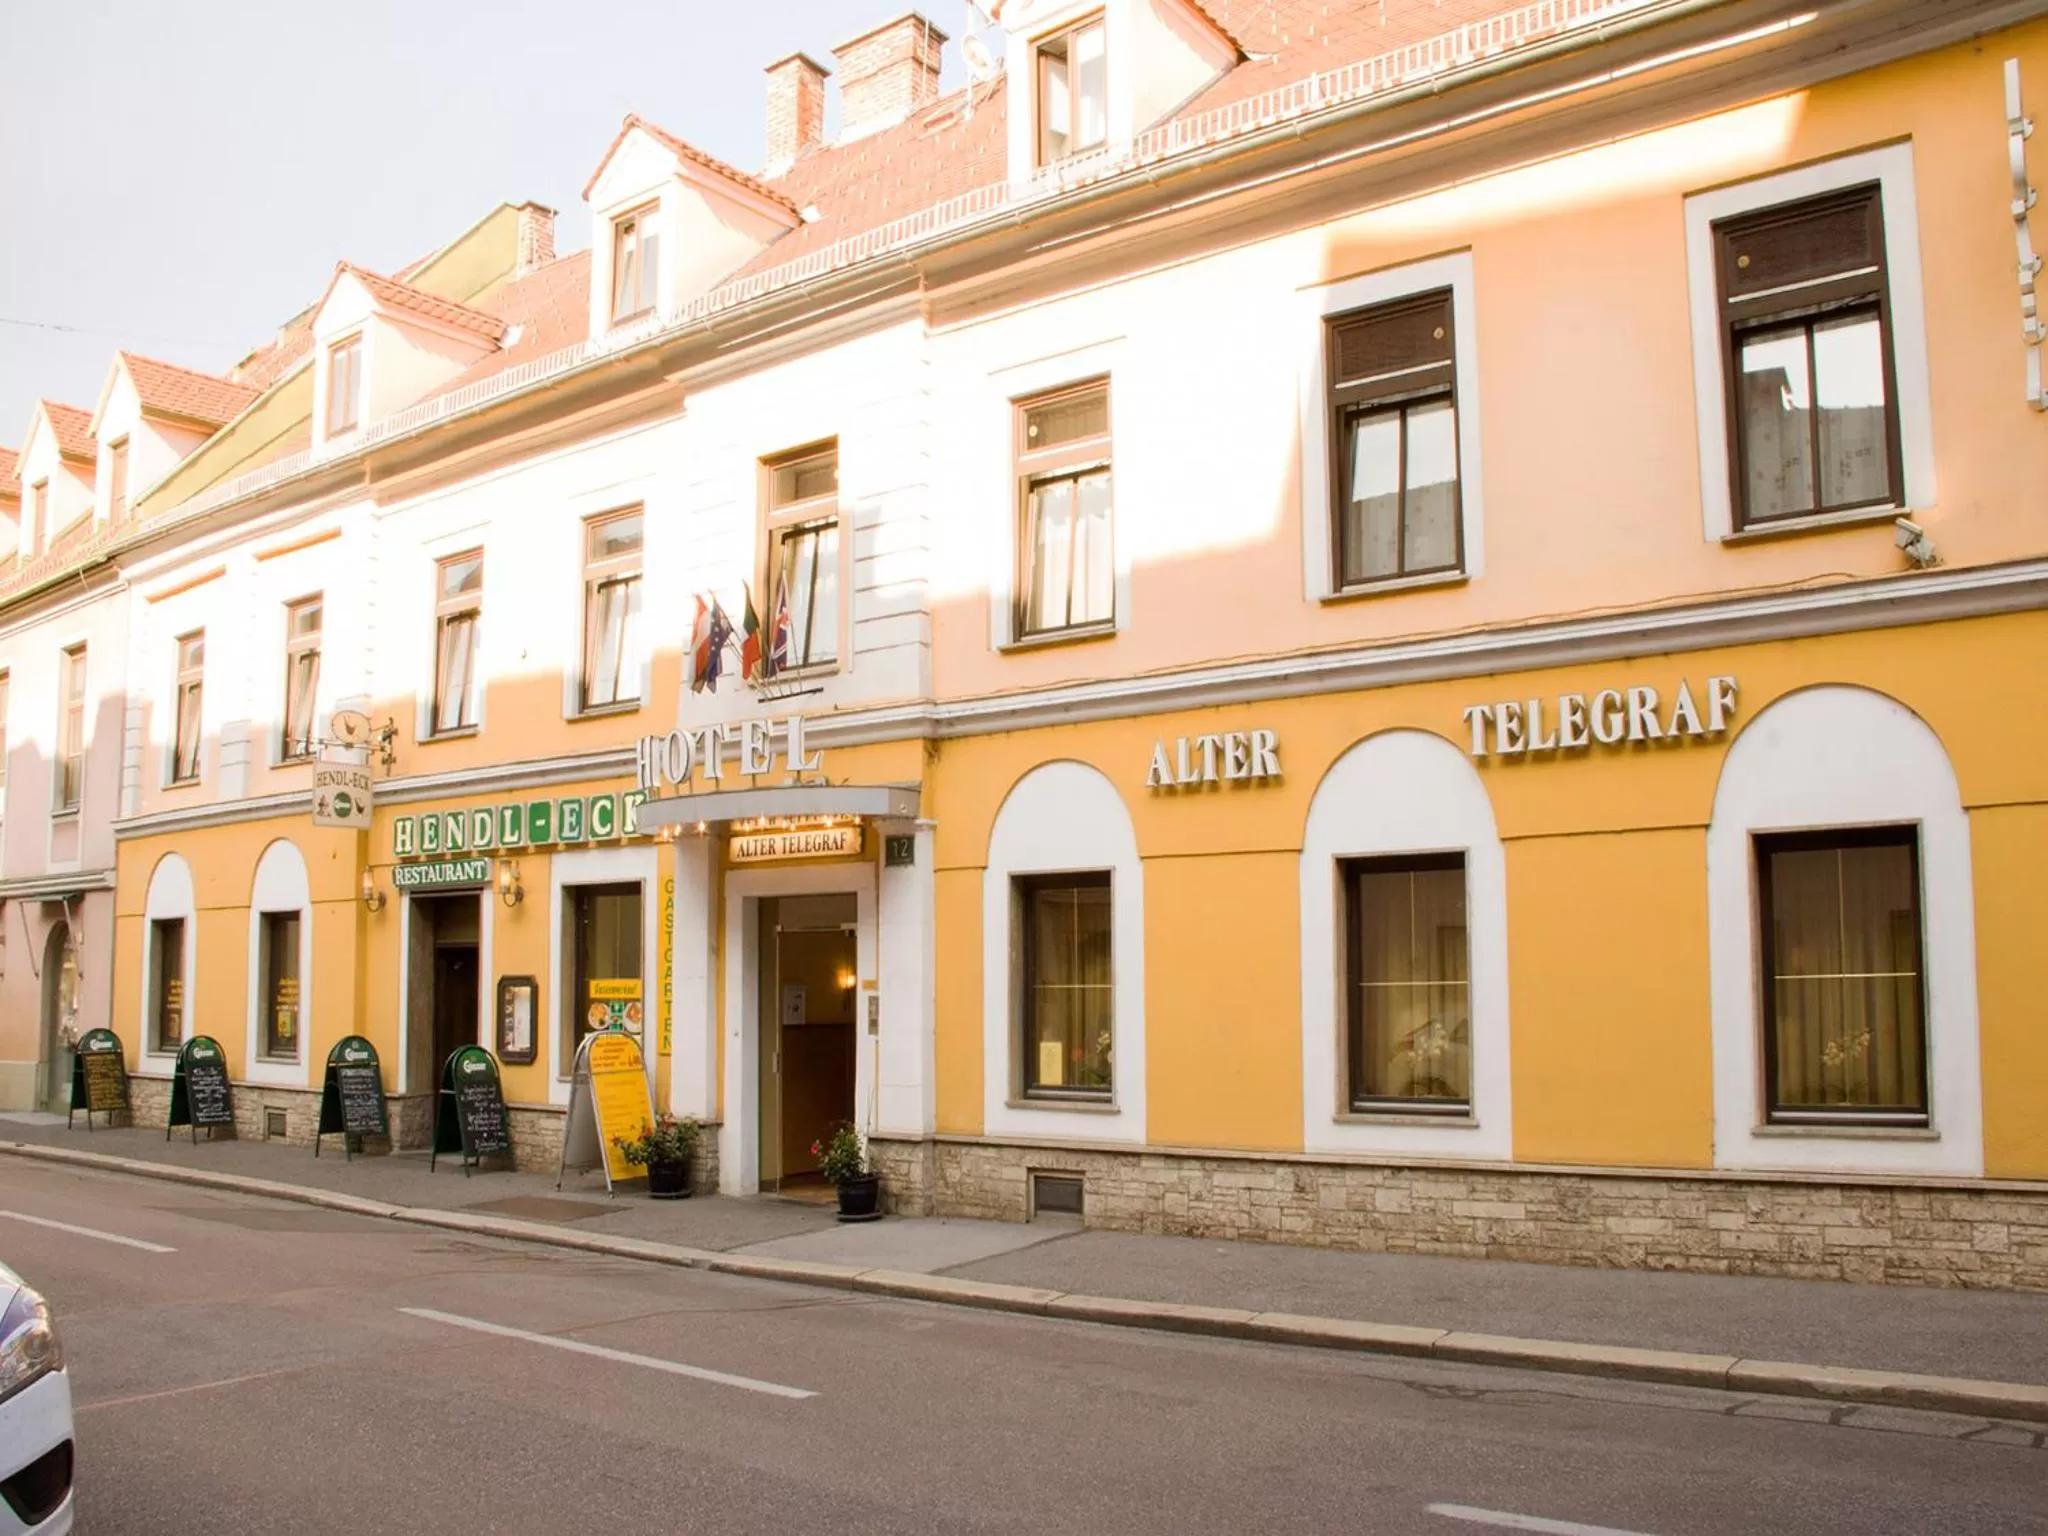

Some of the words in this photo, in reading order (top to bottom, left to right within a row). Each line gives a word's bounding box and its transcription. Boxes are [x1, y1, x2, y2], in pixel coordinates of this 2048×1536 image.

[1463, 676, 1738, 756] TELEGRAF
[636, 715, 822, 788] HOTEL
[1145, 728, 1283, 788] ALTER
[316, 770, 370, 792] HENDL-ECK
[394, 794, 646, 856] HENDL-ECK
[737, 842, 776, 858] ALTER
[782, 832, 848, 854] TELEGRAF
[893, 838, 908, 858] 12
[394, 863, 485, 885] RESTAURANT
